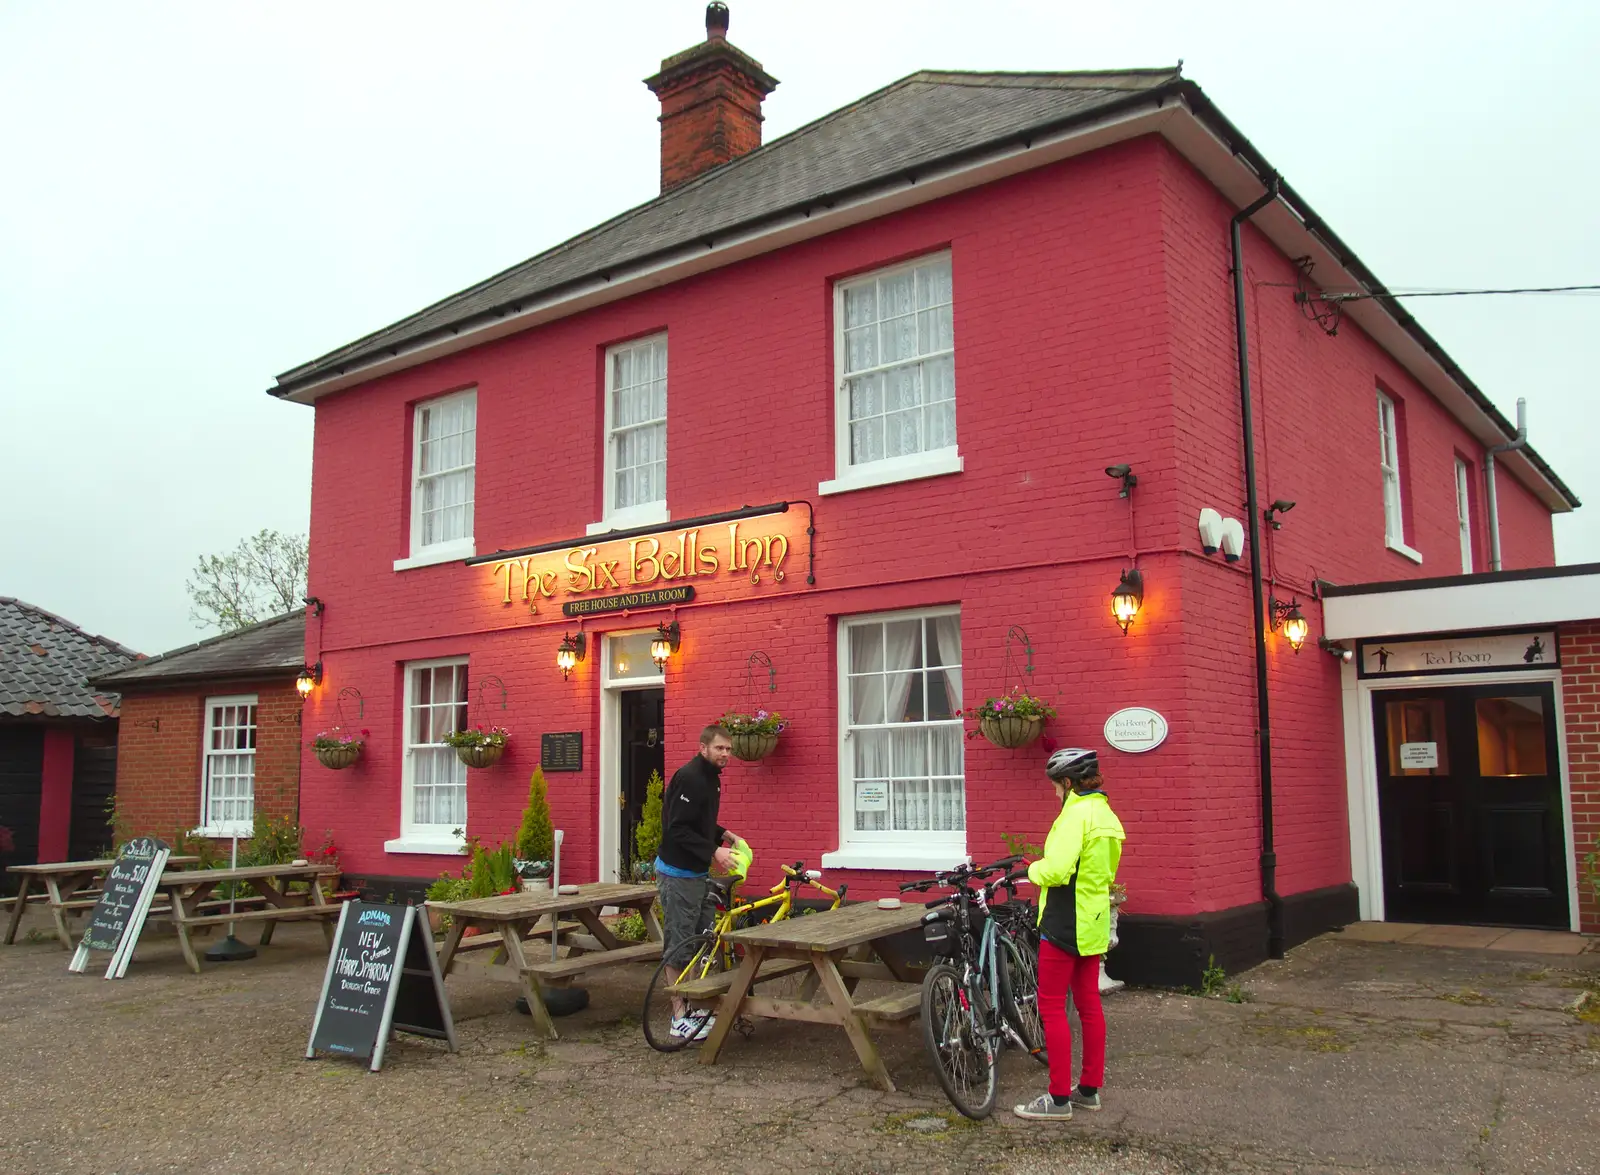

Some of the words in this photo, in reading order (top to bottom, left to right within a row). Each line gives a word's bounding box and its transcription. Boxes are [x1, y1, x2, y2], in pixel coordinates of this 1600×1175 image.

[493, 558, 557, 614] The
[563, 548, 620, 593] Six
[628, 528, 719, 585] Bells
[727, 522, 788, 585] Inn
[570, 600, 590, 613] FREE
[591, 597, 618, 610] HOUSE
[620, 595, 639, 607] AND
[640, 592, 657, 604] TEA
[659, 588, 686, 601] ROOM
[1421, 652, 1446, 665] Tea
[1449, 650, 1492, 665] Room
[1126, 719, 1147, 728] Room
[1114, 729, 1148, 738] Entrance
[357, 910, 391, 926] ADNAMS
[358, 931, 384, 949] NEW
[355, 950, 393, 982] SPARROW
